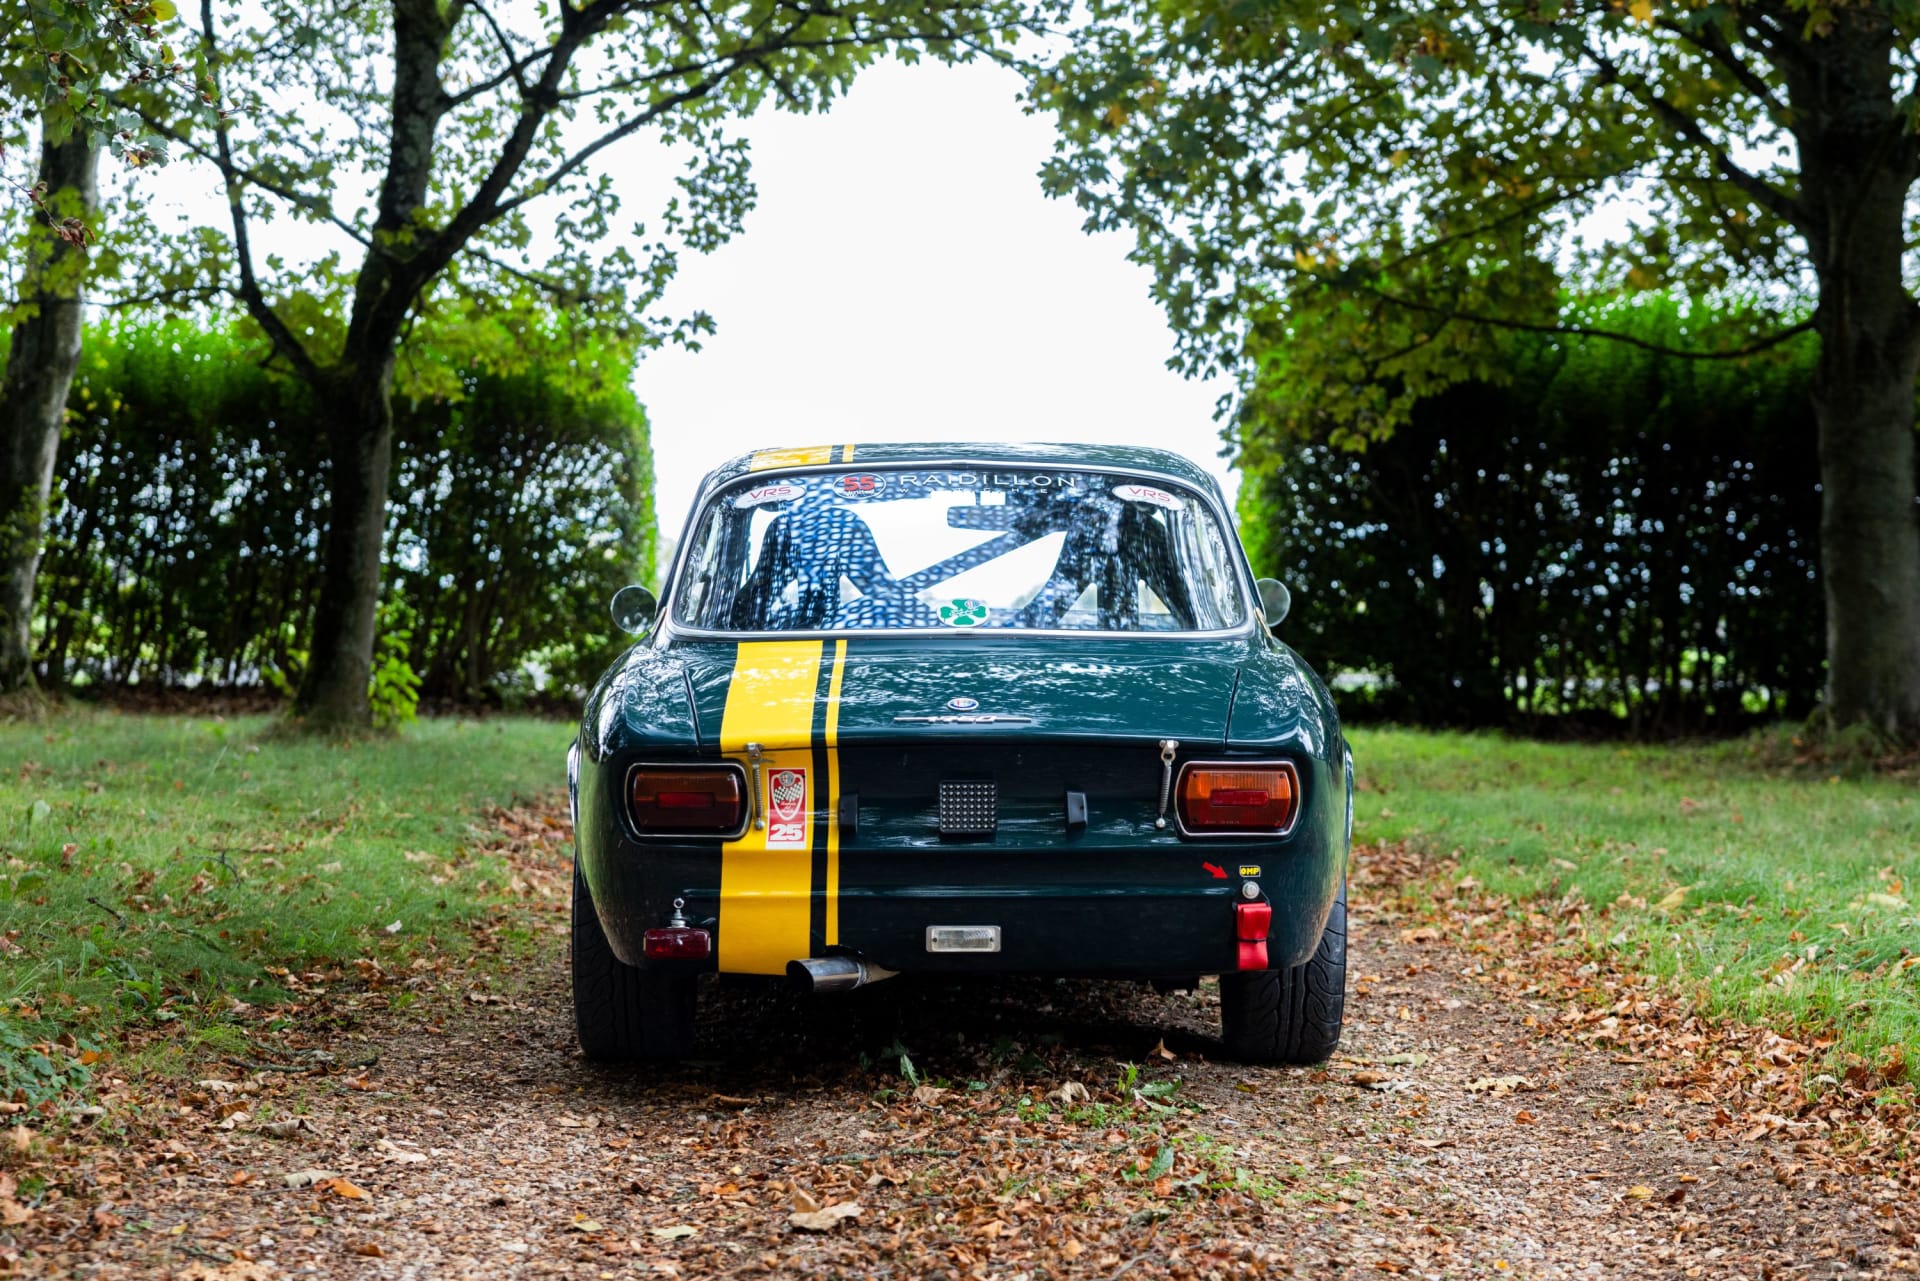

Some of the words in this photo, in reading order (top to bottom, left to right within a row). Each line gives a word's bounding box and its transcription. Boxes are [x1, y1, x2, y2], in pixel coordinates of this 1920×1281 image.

[844, 476, 876, 491] 55
[900, 474, 1075, 487] RAIDILLON
[750, 486, 791, 499] VRS
[1128, 487, 1171, 502] VRS
[770, 823, 803, 841] 25
[1240, 867, 1259, 876] OMP
